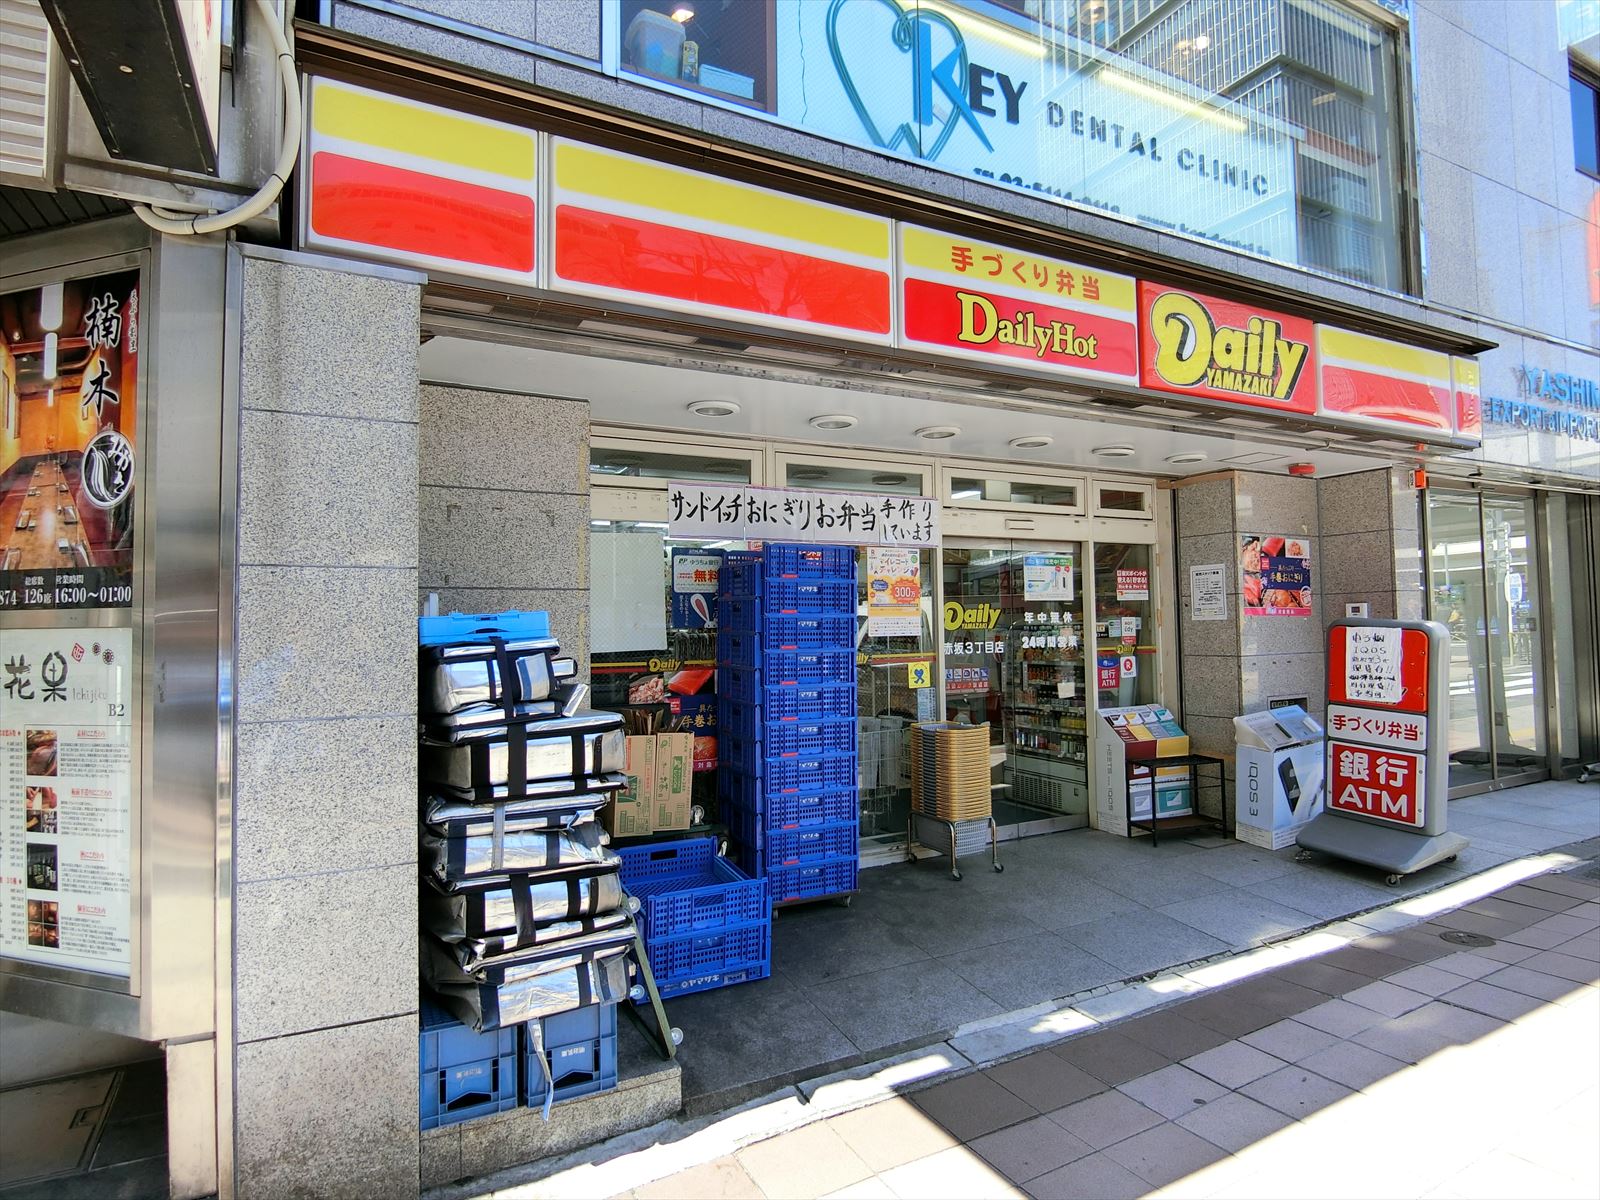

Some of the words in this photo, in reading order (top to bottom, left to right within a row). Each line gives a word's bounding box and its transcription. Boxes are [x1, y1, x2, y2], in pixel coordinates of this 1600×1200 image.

[1047, 101, 1163, 163] DENTAL
[1177, 147, 1269, 197] CLINIC
[951, 245, 1100, 300] 手づくり弁当
[84, 293, 122, 417] 楠木
[1150, 291, 1310, 400] Daily
[1206, 367, 1274, 397] YAMAZAKI
[746, 498, 811, 531] おにぎり
[816, 497, 875, 533] お弁当
[880, 499, 932, 521] 手作り
[883, 521, 935, 542] しています
[694, 569, 719, 583] 無料
[944, 601, 1001, 631] Daily
[1024, 611, 1073, 624] 年中無休
[1021, 636, 1078, 649] 24時間営業
[1355, 646, 1387, 654] IQOS
[648, 658, 682, 673] Daily
[1101, 669, 1116, 679] 銀行
[1101, 679, 1116, 687] ATM
[109, 703, 125, 717] B2
[1332, 714, 1419, 741] 手づくり弁当
[1248, 761, 1259, 804] IQOS
[1339, 750, 1409, 788] 銀行
[1249, 808, 1259, 816] 3
[1338, 783, 1409, 818] ATM
